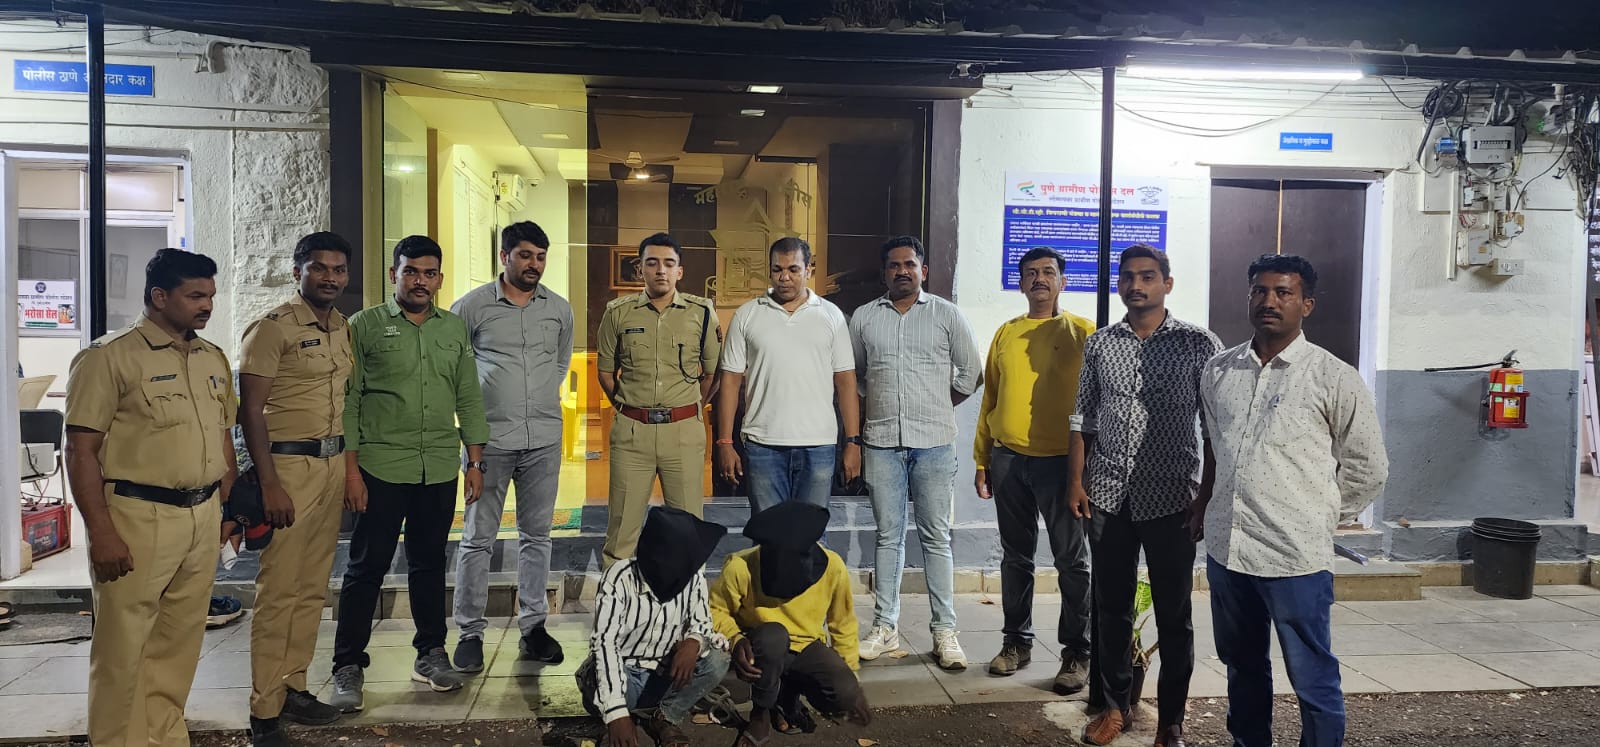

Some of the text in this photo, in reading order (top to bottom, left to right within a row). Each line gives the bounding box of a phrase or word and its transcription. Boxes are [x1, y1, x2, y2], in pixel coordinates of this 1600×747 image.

[22, 67, 55, 82] पोलीस
[58, 69, 78, 83] ठाणे
[127, 75, 146, 87] कक्ष
[1041, 182, 1055, 195] पुणे
[1059, 184, 1086, 194] ग्रामीण
[1088, 184, 1117, 196] पोस
[1120, 187, 1135, 197] दल
